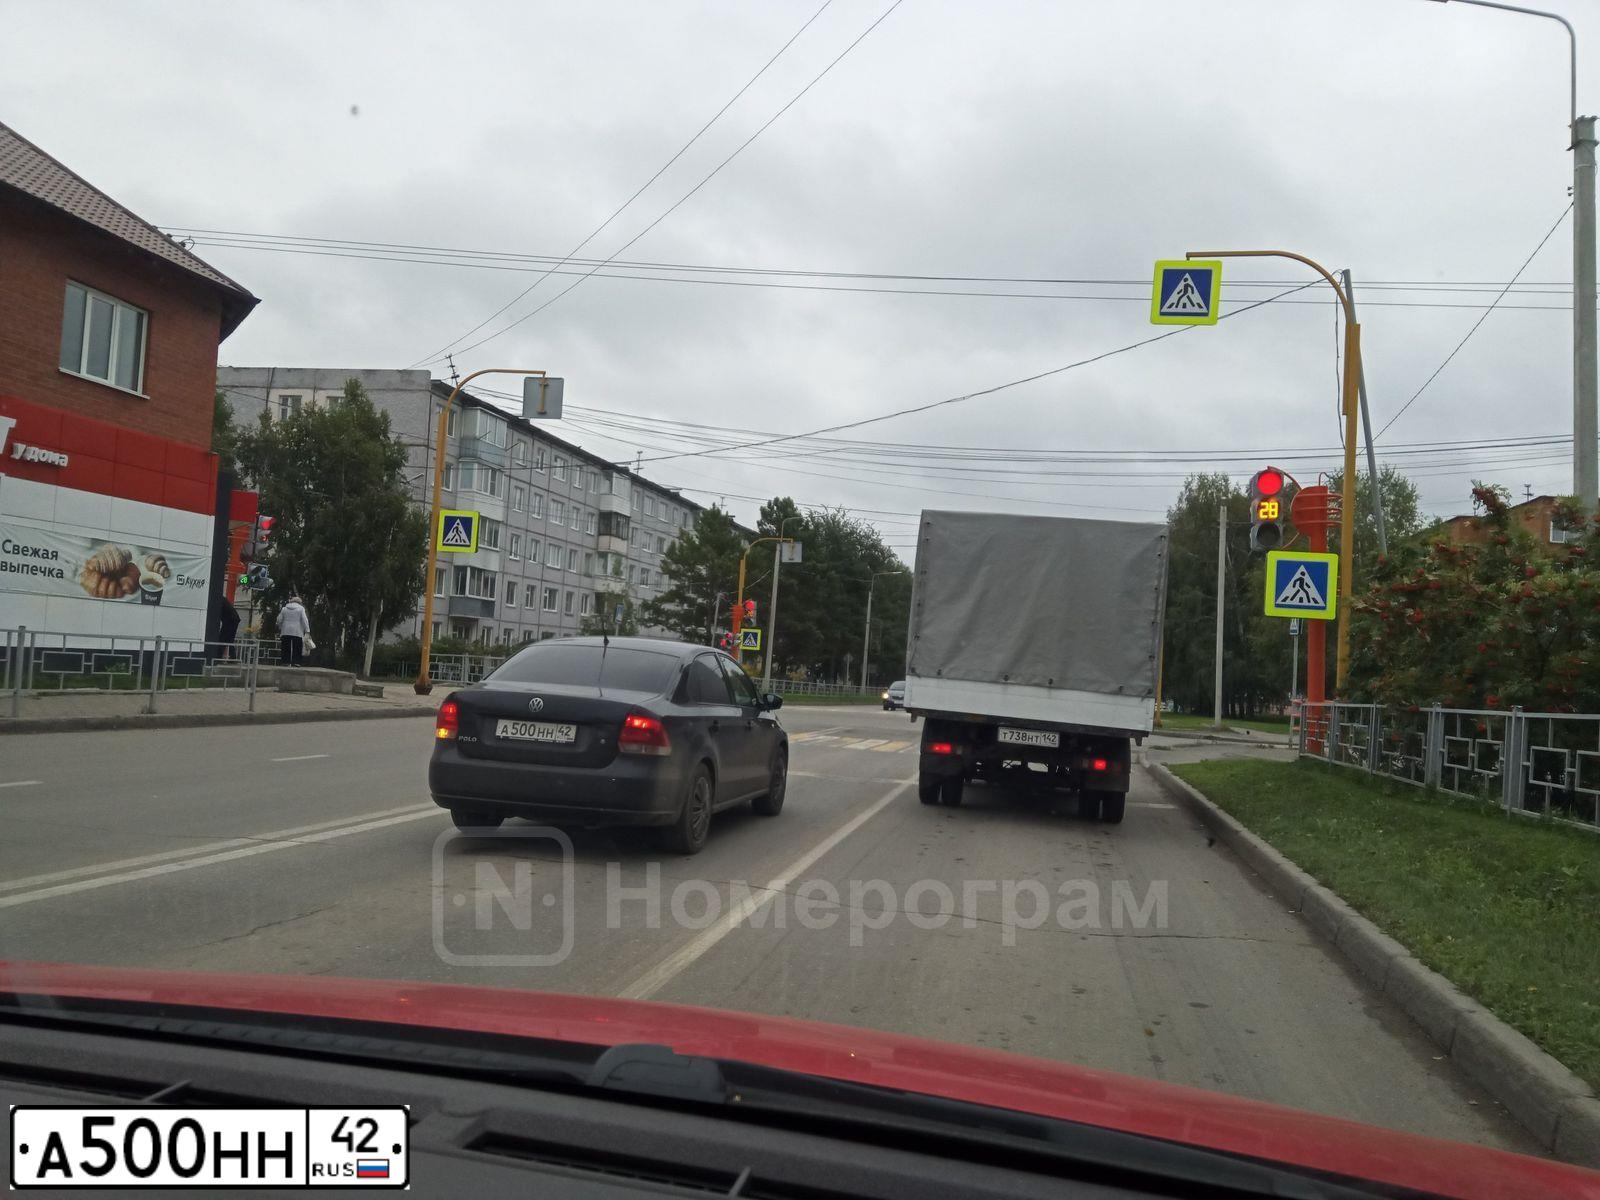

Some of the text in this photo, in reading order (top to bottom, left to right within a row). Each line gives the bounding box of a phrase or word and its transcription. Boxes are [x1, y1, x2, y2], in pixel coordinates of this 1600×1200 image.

[1258, 501, 1279, 519] 28
[2, 539, 59, 561] Свежая
[0, 560, 64, 579] выпечка
[500, 722, 572, 739] А500НН 42
[1002, 730, 1057, 743] Т738НТ 142
